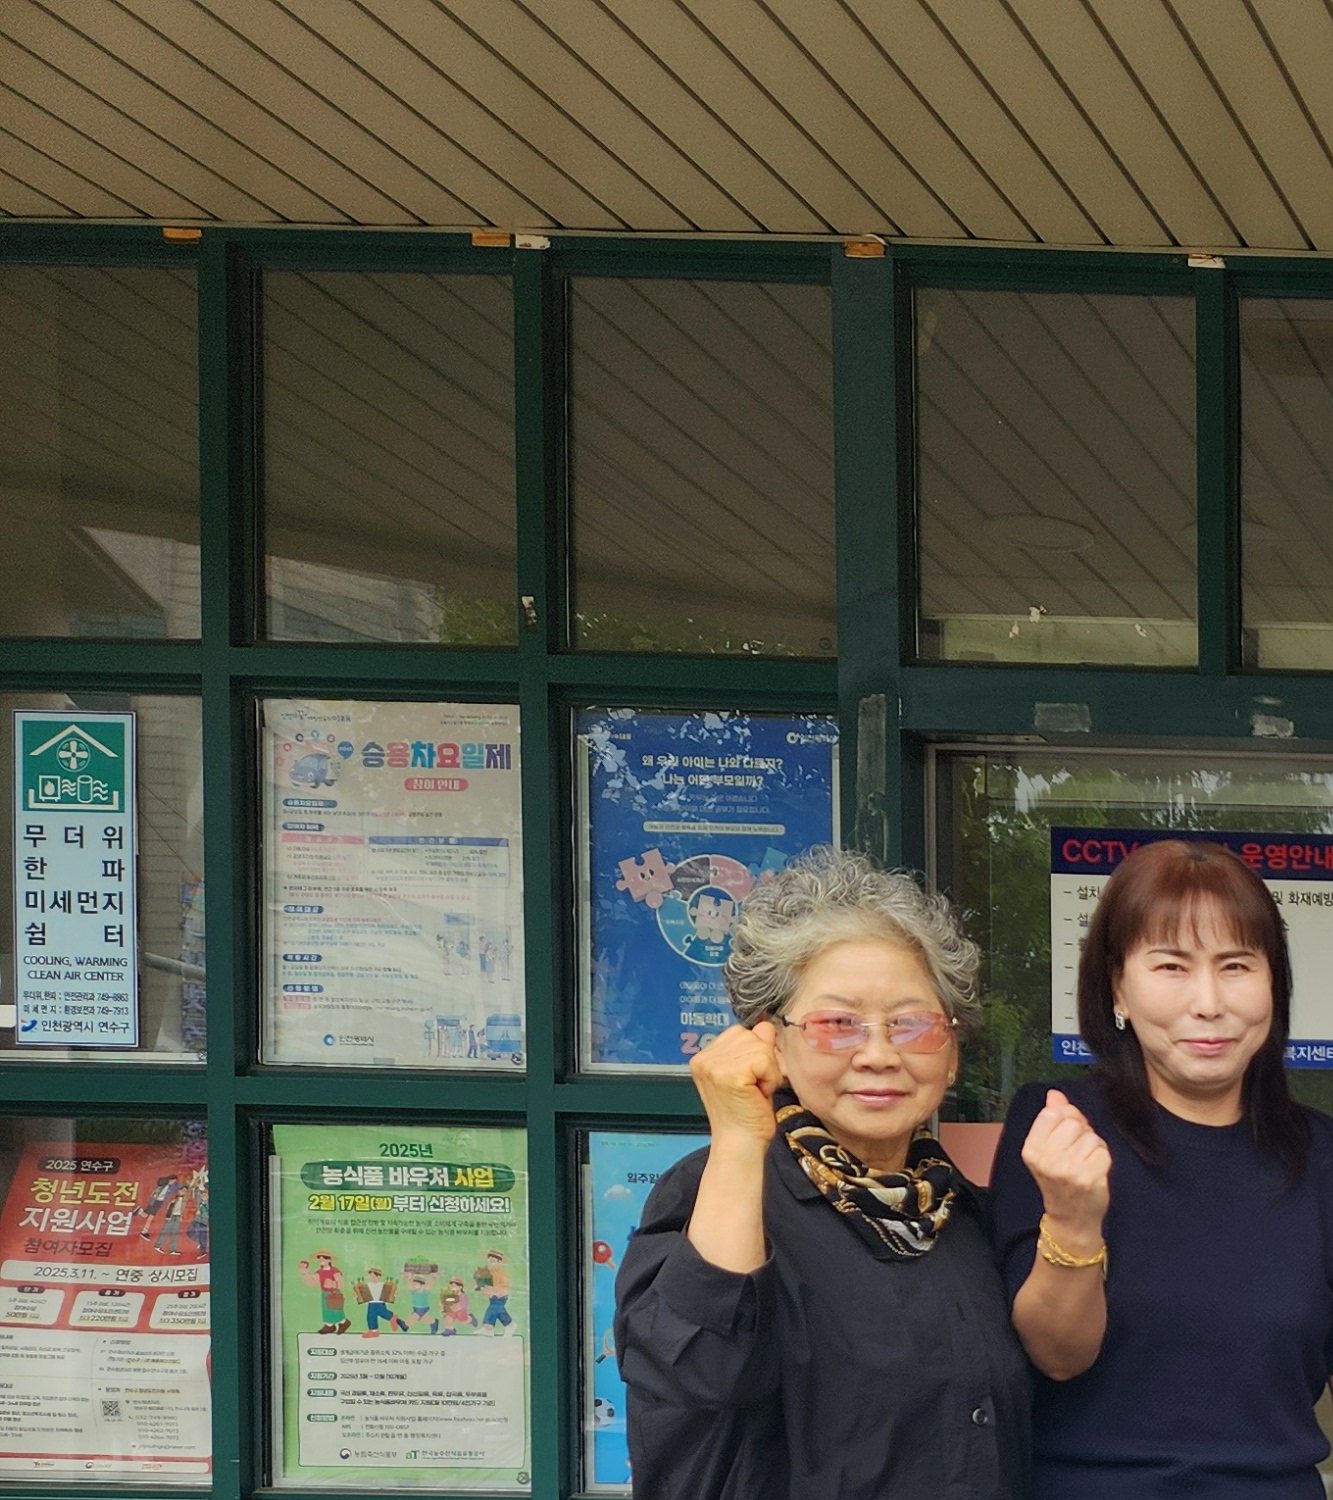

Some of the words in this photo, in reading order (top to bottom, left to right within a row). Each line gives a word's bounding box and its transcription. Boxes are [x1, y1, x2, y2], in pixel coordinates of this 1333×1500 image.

[361, 740, 512, 770] 승용차요일제
[682, 756, 715, 769] 아이는
[25, 889, 124, 915] 미세먼지
[23, 955, 72, 967] COOLING,
[75, 956, 127, 967] WARMING
[27, 970, 61, 981] CLEAN
[64, 971, 81, 981] AIR
[83, 971, 124, 982] CENTER
[41, 1020, 94, 1033] 인천광역시
[98, 1021, 130, 1033] 연수구
[379, 1143, 434, 1158] 2025년
[45, 1159, 77, 1170] 2025
[80, 1160, 114, 1172] 연수구
[322, 1165, 384, 1186] 농식품
[388, 1166, 450, 1187] 바우처
[454, 1166, 494, 1188] 사업
[30, 1177, 139, 1207] 청년도전
[308, 1194, 336, 1211] 2월
[428, 1196, 511, 1214] 신청하세요!
[18, 1207, 133, 1236] 지원사업
[23, 1237, 113, 1257] 참여자모집
[33, 1266, 97, 1280] 2025.3.11.
[115, 1268, 144, 1283] 연중
[148, 1268, 198, 1283] 상시모집
